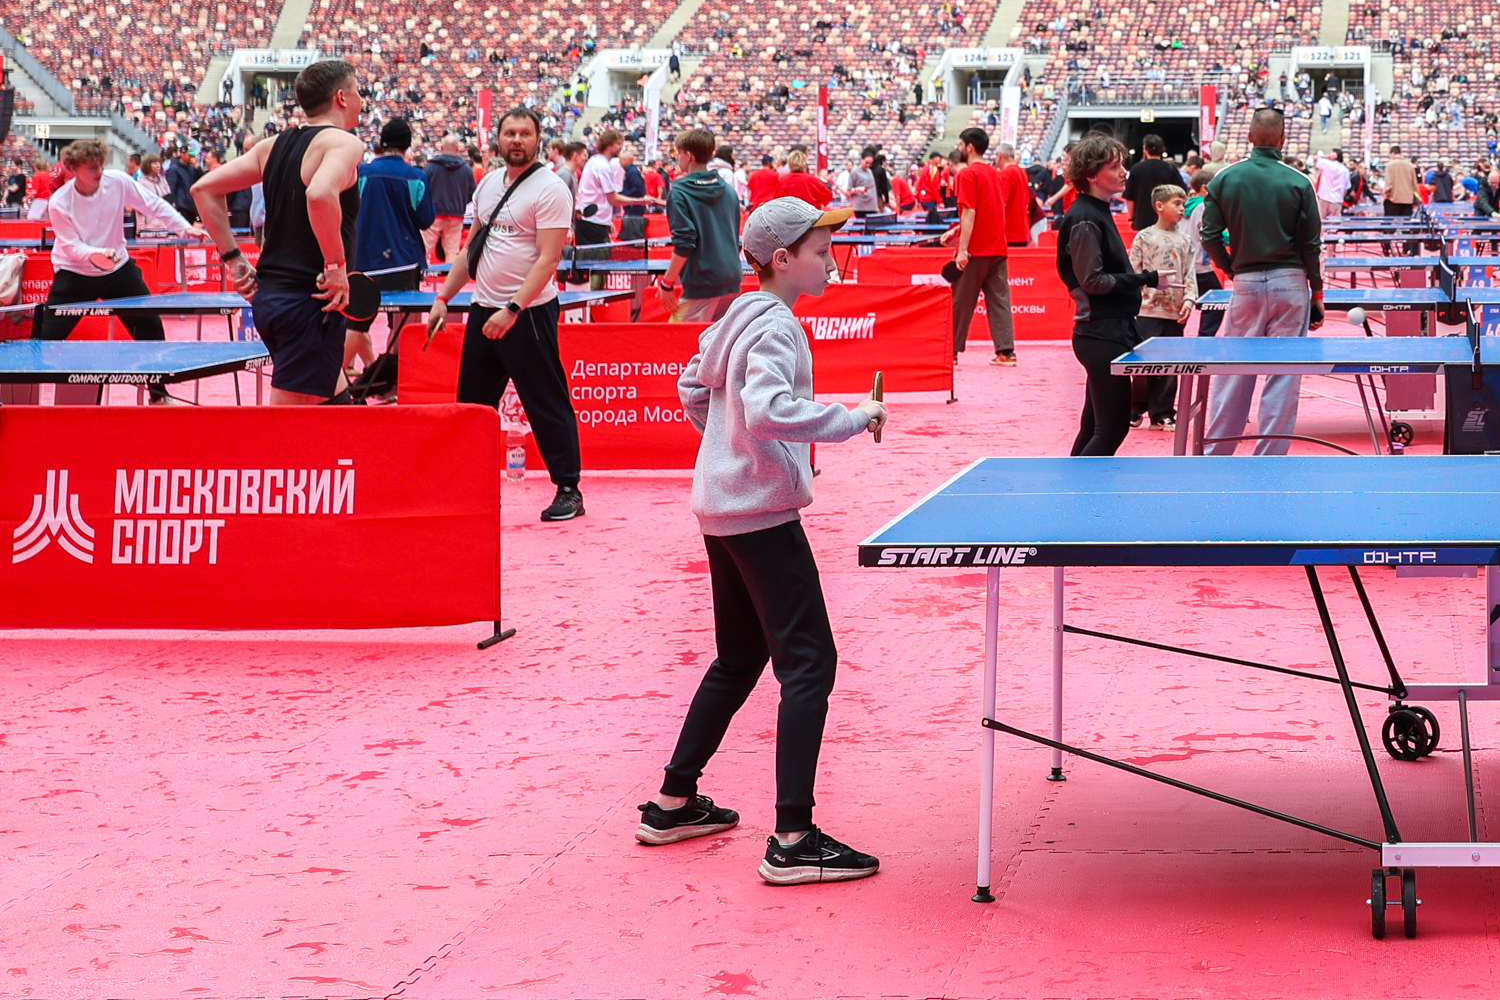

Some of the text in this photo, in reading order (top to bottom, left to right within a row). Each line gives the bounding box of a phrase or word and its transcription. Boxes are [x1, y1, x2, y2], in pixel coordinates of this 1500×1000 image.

[965, 54, 982, 62] 124
[1312, 52, 1361, 60] 122 121
[1010, 305, 1046, 314] осквы
[571, 359, 690, 381] Департамен
[1123, 364, 1174, 375] START
[68, 373, 162, 385] COMPACT OUTDOOR LX
[571, 385, 637, 404] спорта
[643, 405, 690, 422] Моск
[114, 459, 356, 514] МОСКОВСКИЙ
[111, 519, 226, 565] СПОРТ
[877, 547, 972, 565] START
